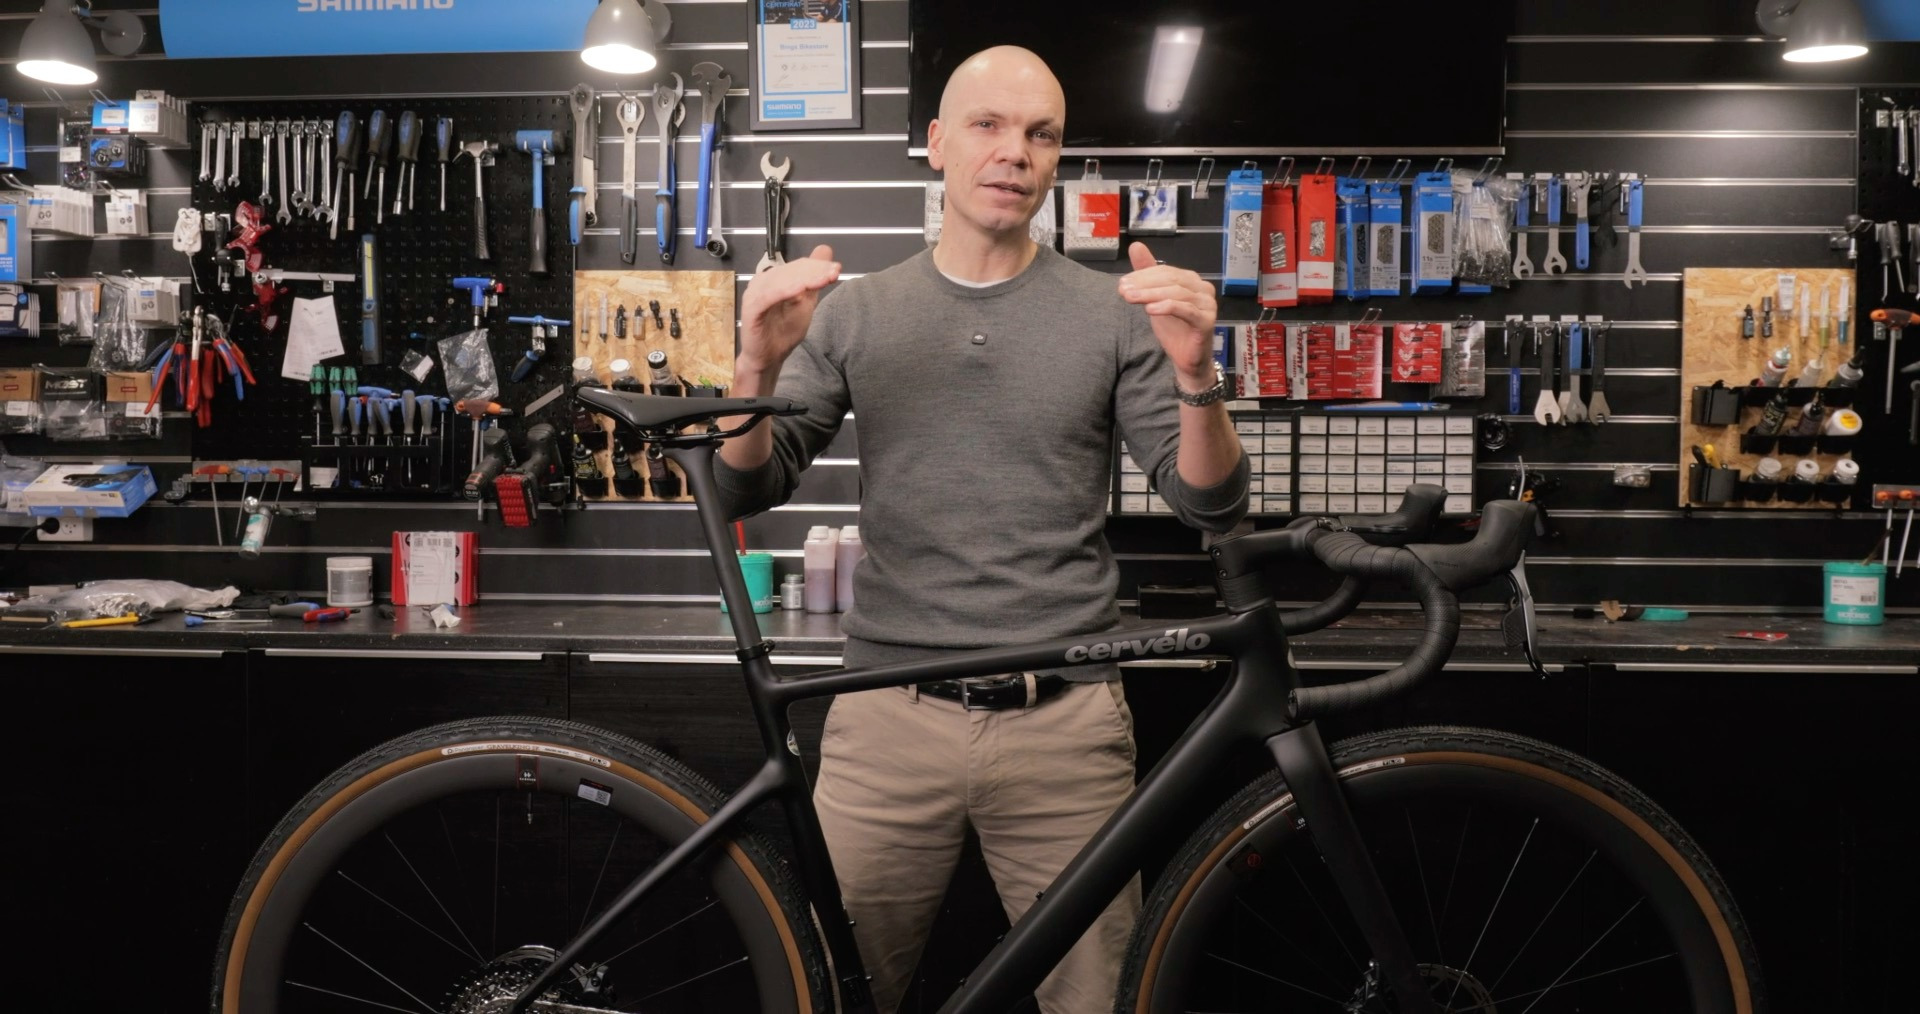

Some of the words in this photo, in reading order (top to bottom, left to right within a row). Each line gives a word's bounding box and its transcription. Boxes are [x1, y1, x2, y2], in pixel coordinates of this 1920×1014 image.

[793, 19, 816, 29] 2023
[1246, 326, 1254, 365] SRAM
[45, 378, 87, 390] MOST
[1064, 628, 1211, 663] cervélo
[486, 743, 530, 751] GRAVELKING
